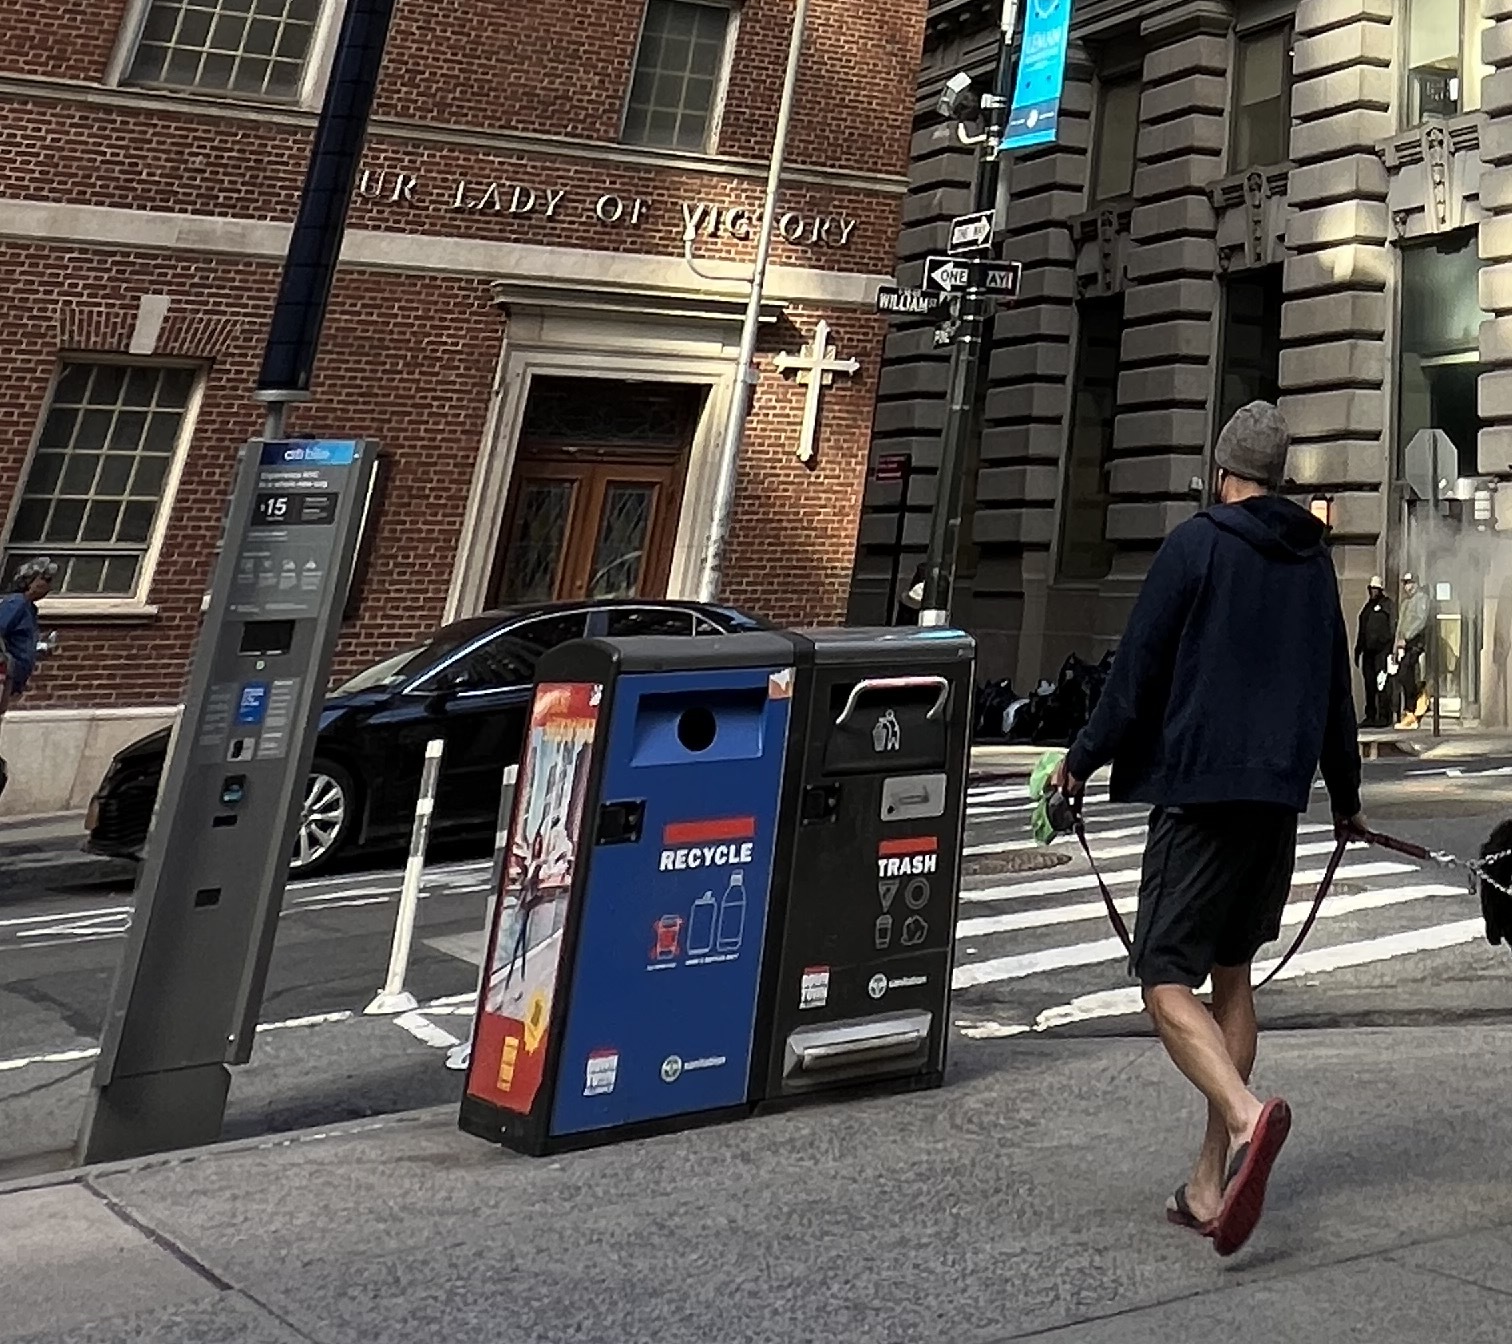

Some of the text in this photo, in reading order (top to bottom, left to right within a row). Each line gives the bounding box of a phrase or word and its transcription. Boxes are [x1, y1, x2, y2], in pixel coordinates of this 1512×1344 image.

[359, 169, 857, 245] UR LADY OF VICORY
[940, 269, 1011, 288] ONE AY
[879, 292, 928, 314] WILLIAM
[658, 842, 754, 872] RECYCLE
[877, 854, 938, 878] TRASH
